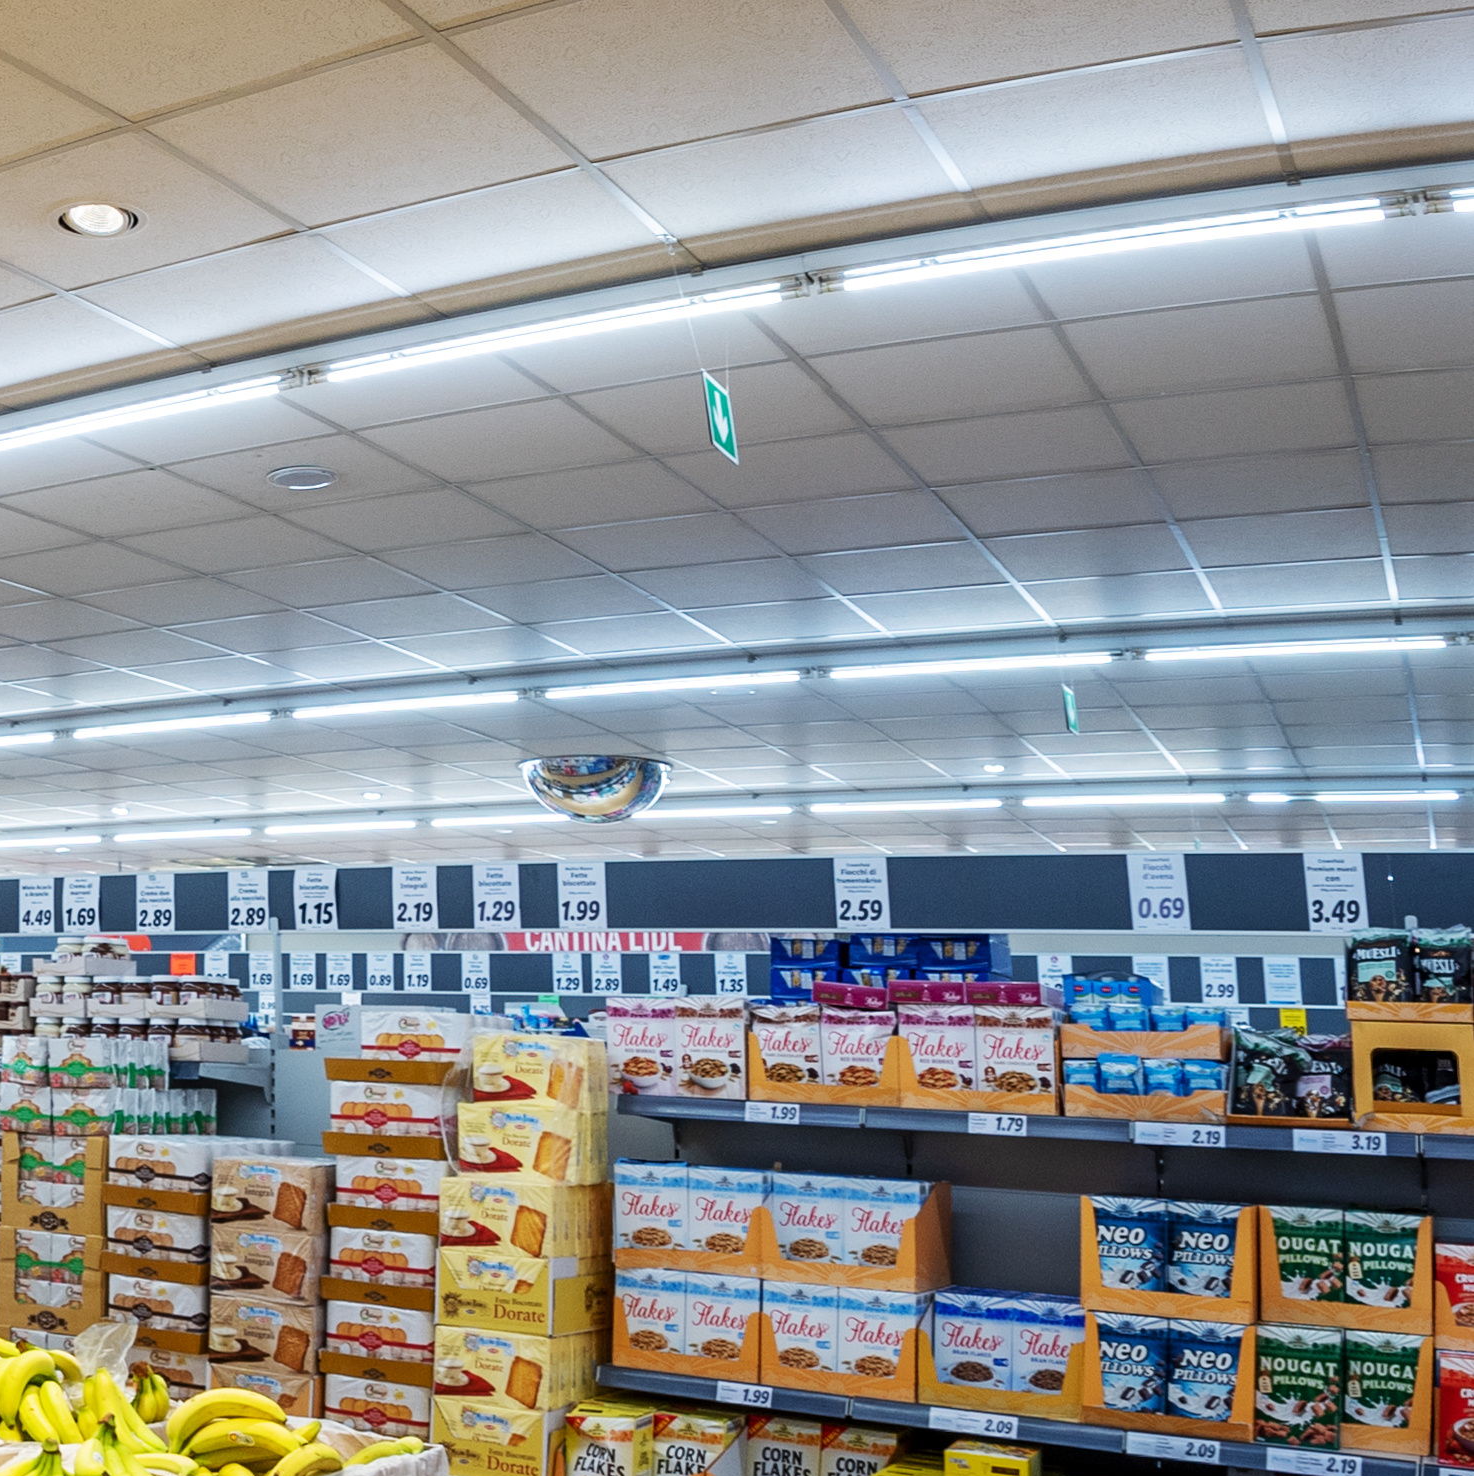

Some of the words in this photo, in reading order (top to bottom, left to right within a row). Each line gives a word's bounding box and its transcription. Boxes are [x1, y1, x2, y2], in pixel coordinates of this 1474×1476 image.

[1143, 863, 1172, 872] Fiocchi
[66, 907, 95, 925] 1.69
[231, 907, 266, 926] 2.89
[298, 902, 333, 925] 1.15
[396, 902, 433, 922] 2.19
[477, 900, 515, 922] 1.29
[561, 900, 600, 921] 1.99
[839, 899, 882, 921] 2.59
[1138, 897, 1185, 919] 0.69
[1311, 900, 1360, 924] 3.49
[23, 909, 51, 926] 4.49
[139, 909, 172, 927] 2.89
[525, 932, 620, 952] CANTINA
[629, 932, 683, 952] LIDL
[1357, 946, 1396, 960] MUESLI
[252, 973, 272, 985] 1.69
[292, 973, 313, 986] 1.69
[369, 974, 392, 986] 0.89
[406, 974, 429, 988] 1.19
[464, 977, 487, 990] 0.69
[555, 977, 580, 991] 1.29
[594, 978, 619, 991] 2.89
[652, 978, 678, 992] 1.49
[719, 978, 744, 993] 1.35
[1205, 984, 1234, 998] 2.99
[613, 1024, 668, 1051] Flakes
[681, 1024, 736, 1051] Flakes
[770, 1105, 797, 1121] 1.99
[995, 1116, 1024, 1132] 1.79
[1192, 1130, 1221, 1144] 2.19
[1352, 1135, 1381, 1150] 3.19
[1363, 1259, 1414, 1274] PILLOWS
[492, 1304, 546, 1323] Dorate
[1260, 1356, 1337, 1378] NOUGAT
[1273, 1375, 1324, 1390] PILLOWS
[742, 1388, 770, 1405] 1.99
[983, 1418, 1013, 1435] 2.09
[585, 1442, 616, 1462] CORN
[665, 1445, 707, 1463] CORN
[761, 1446, 803, 1465] CORN
[1185, 1443, 1216, 1458] 2.09
[487, 1457, 539, 1476] Dorate
[835, 1457, 878, 1476] CORN
[1326, 1457, 1356, 1474] 2.19
